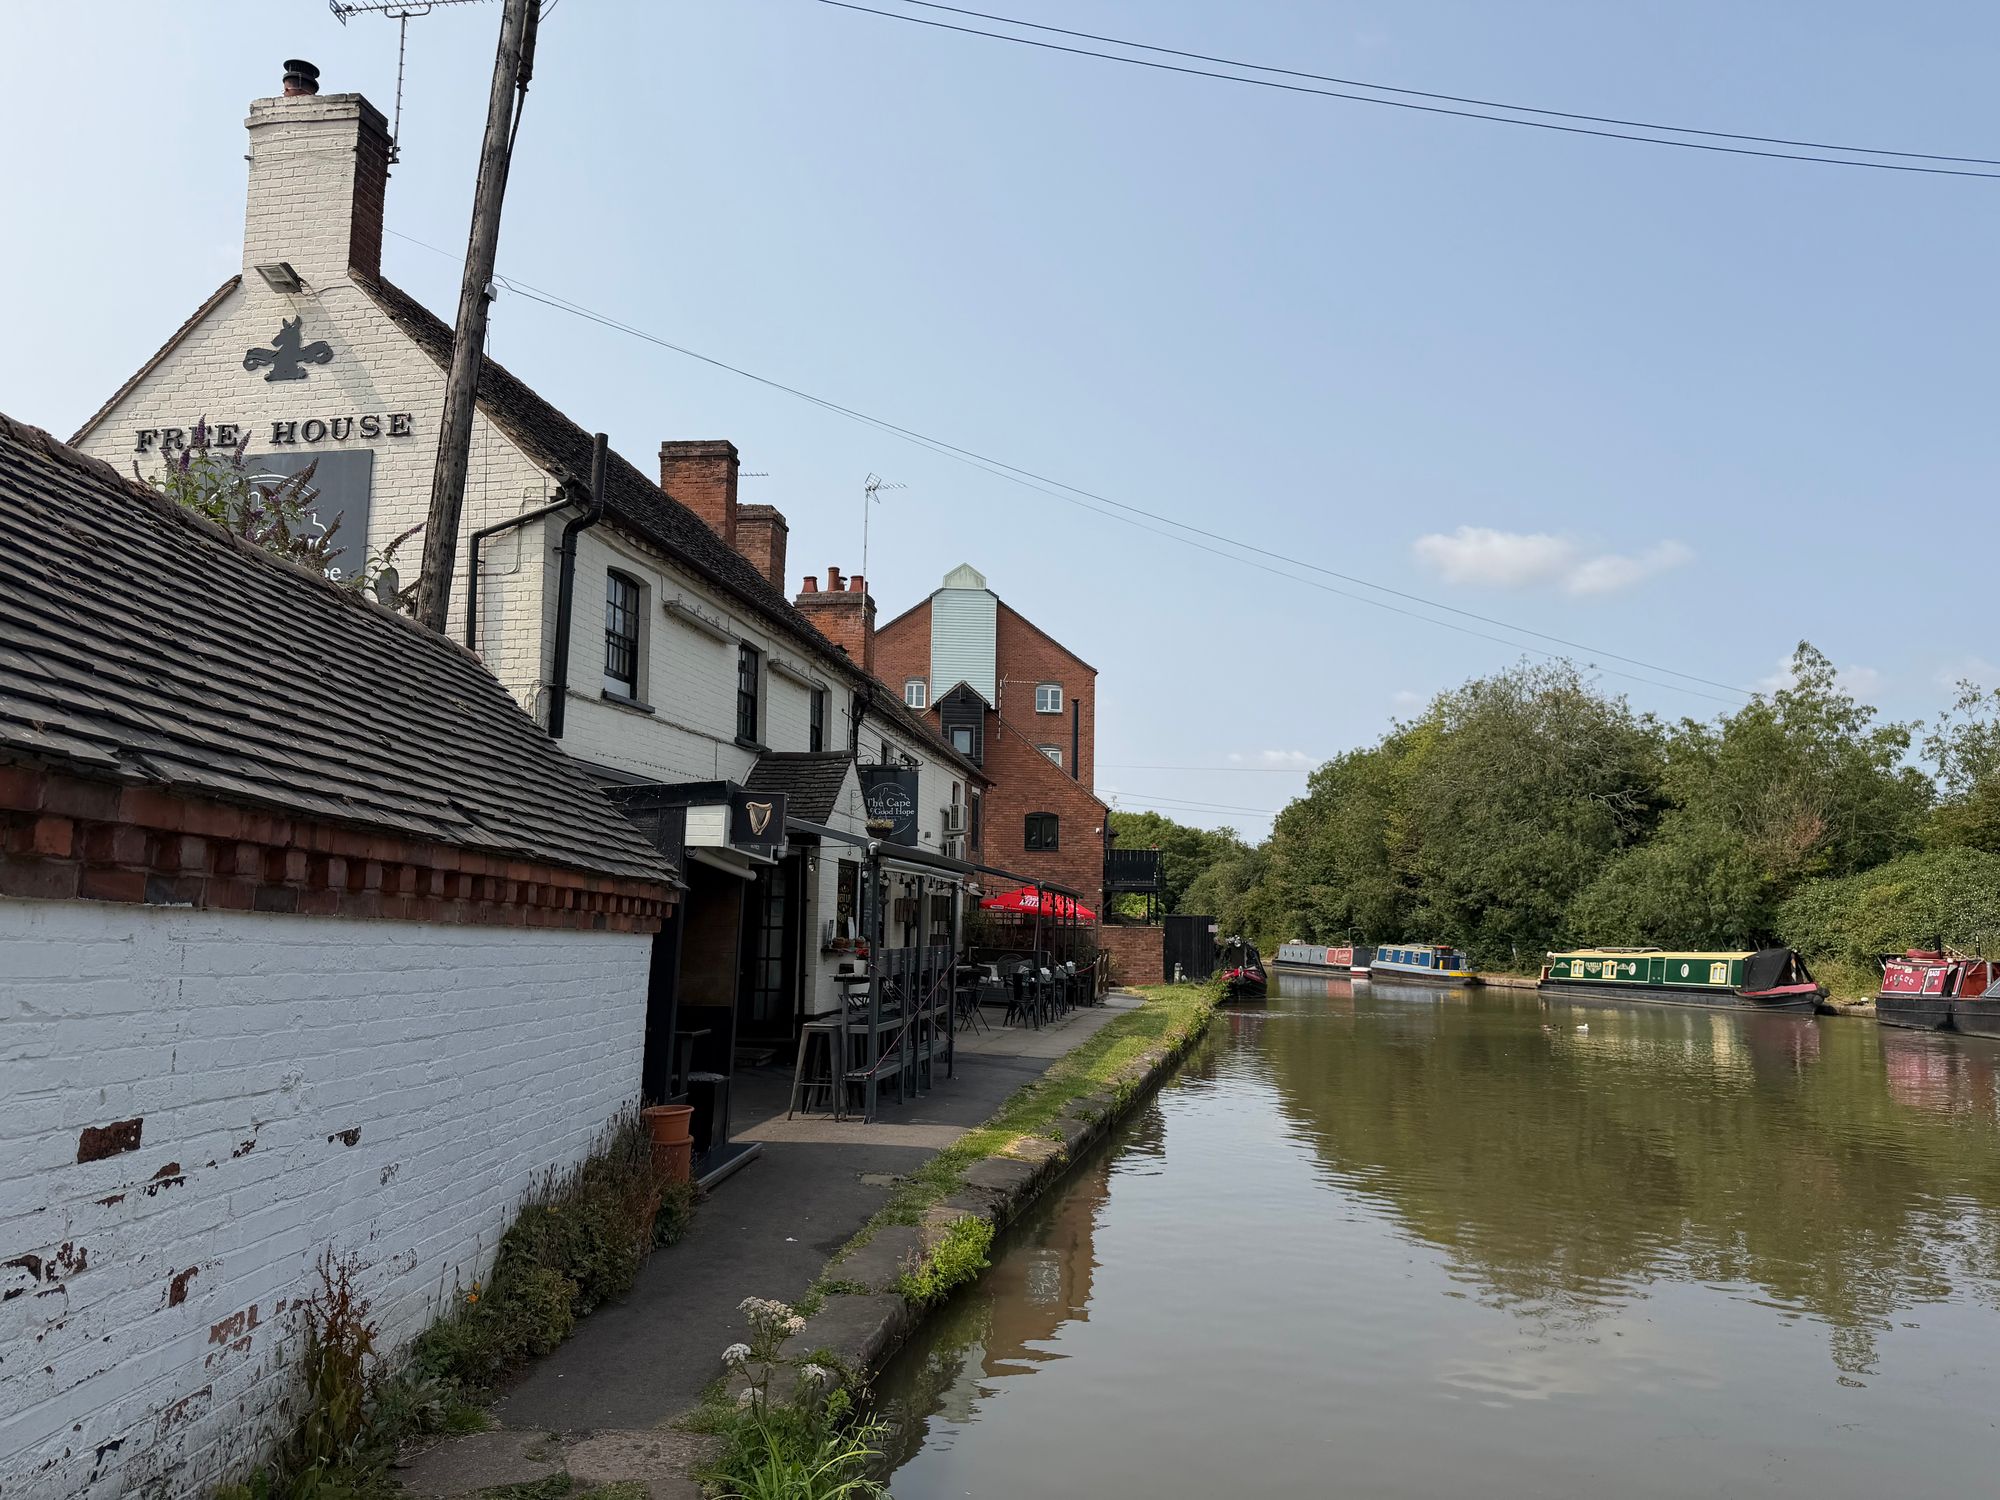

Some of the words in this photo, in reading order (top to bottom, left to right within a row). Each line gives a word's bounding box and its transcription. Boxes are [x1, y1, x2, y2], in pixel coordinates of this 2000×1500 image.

[134, 423, 239, 452] FREE
[269, 413, 412, 443] HOUSE
[867, 798, 884, 806] The
[886, 798, 910, 809] Cape
[896, 808, 914, 816] Hope
